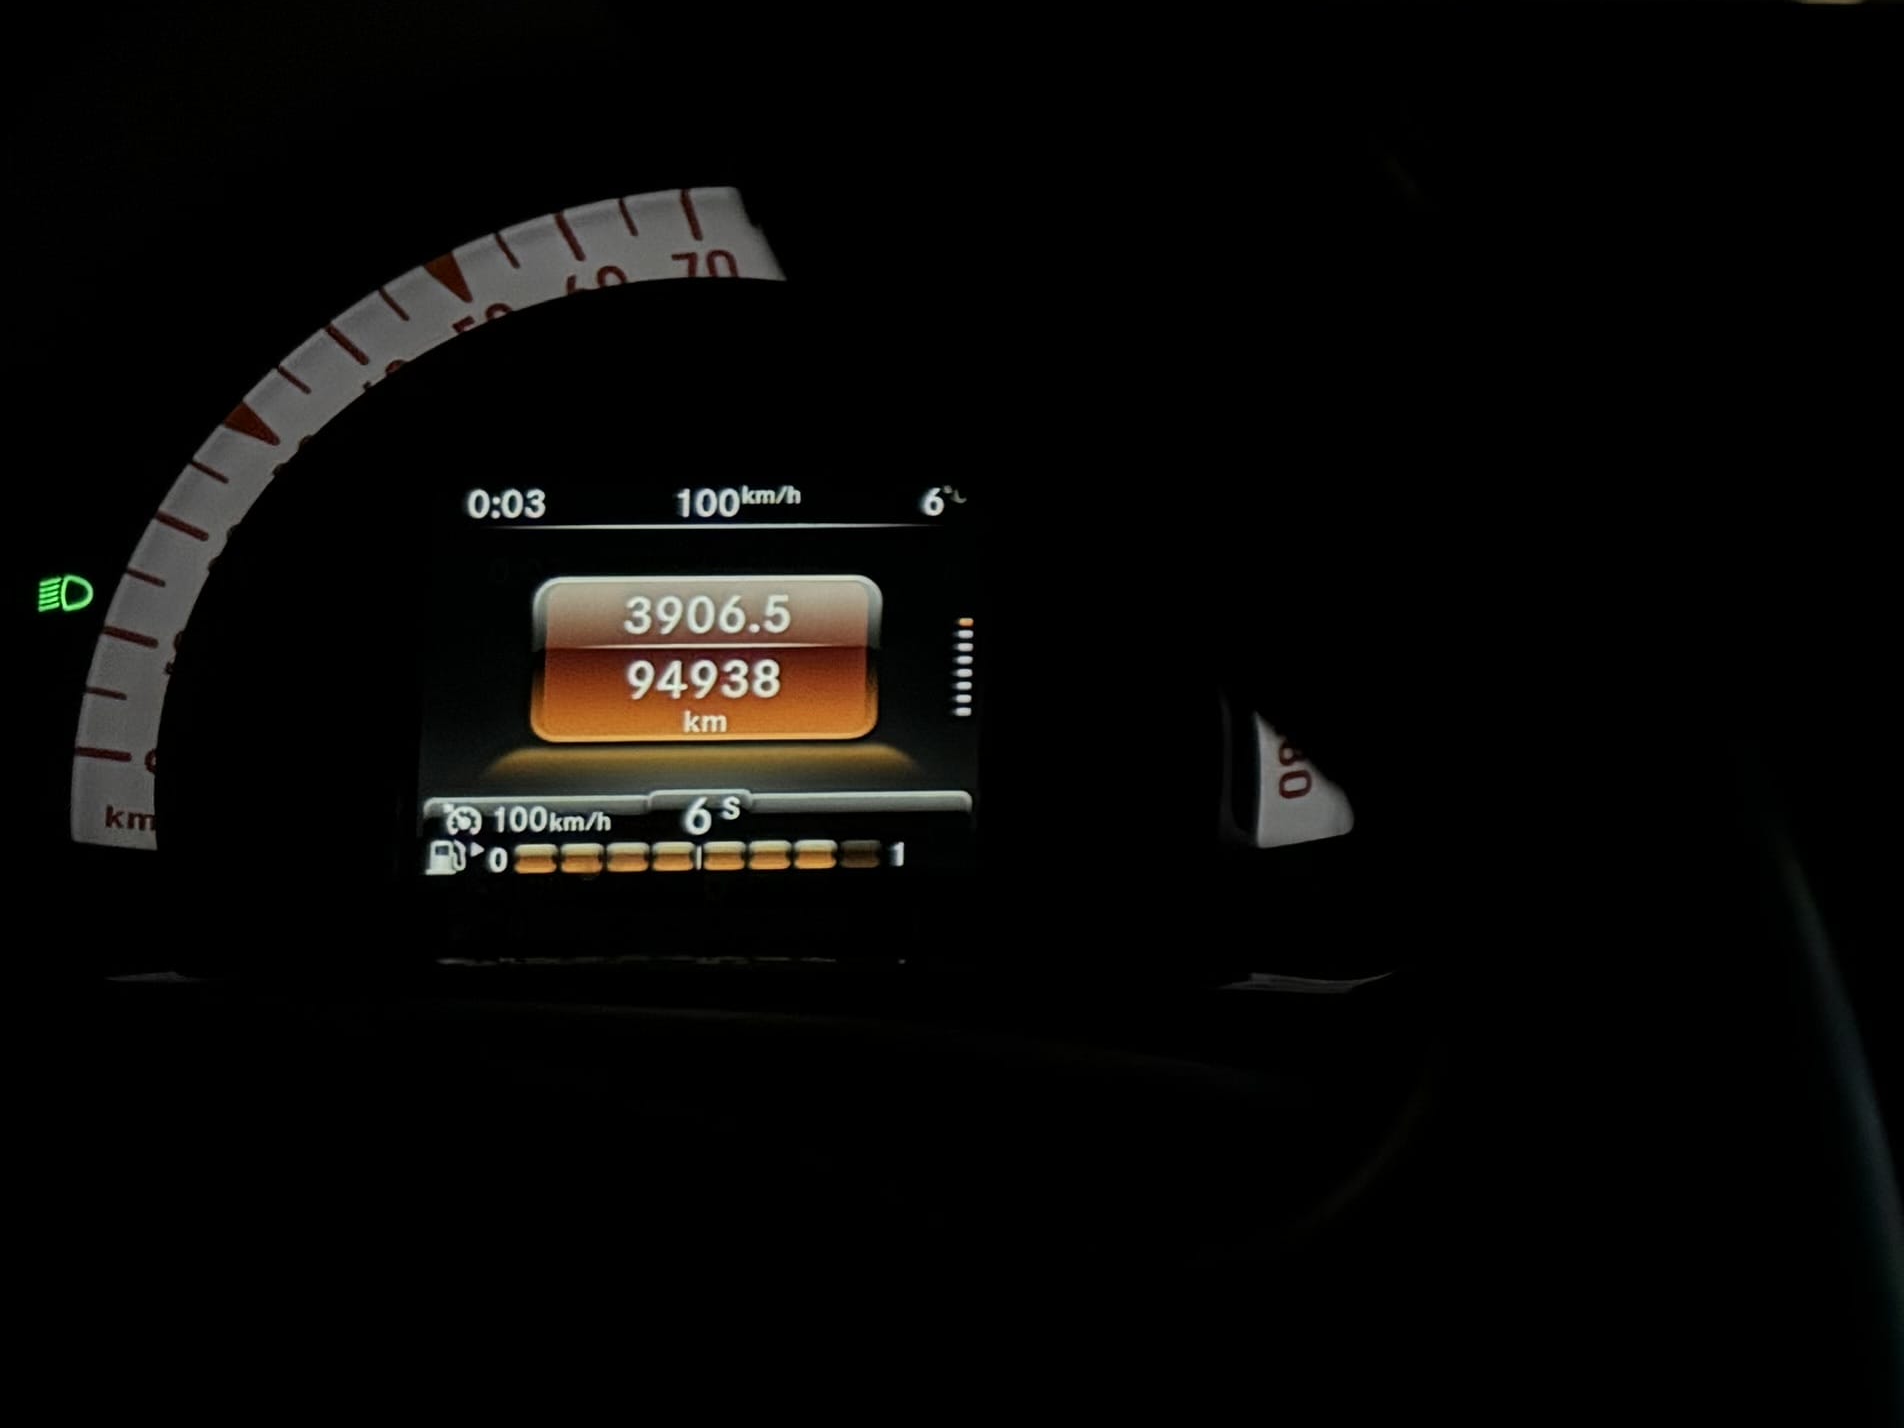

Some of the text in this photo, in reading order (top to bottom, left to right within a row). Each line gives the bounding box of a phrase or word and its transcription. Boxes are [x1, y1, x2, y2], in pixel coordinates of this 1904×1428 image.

[466, 487, 547, 519] 0:03
[623, 593, 792, 635] 3906.5
[625, 658, 782, 701] 94938
[682, 710, 728, 734] km
[493, 804, 612, 834] 100km/h
